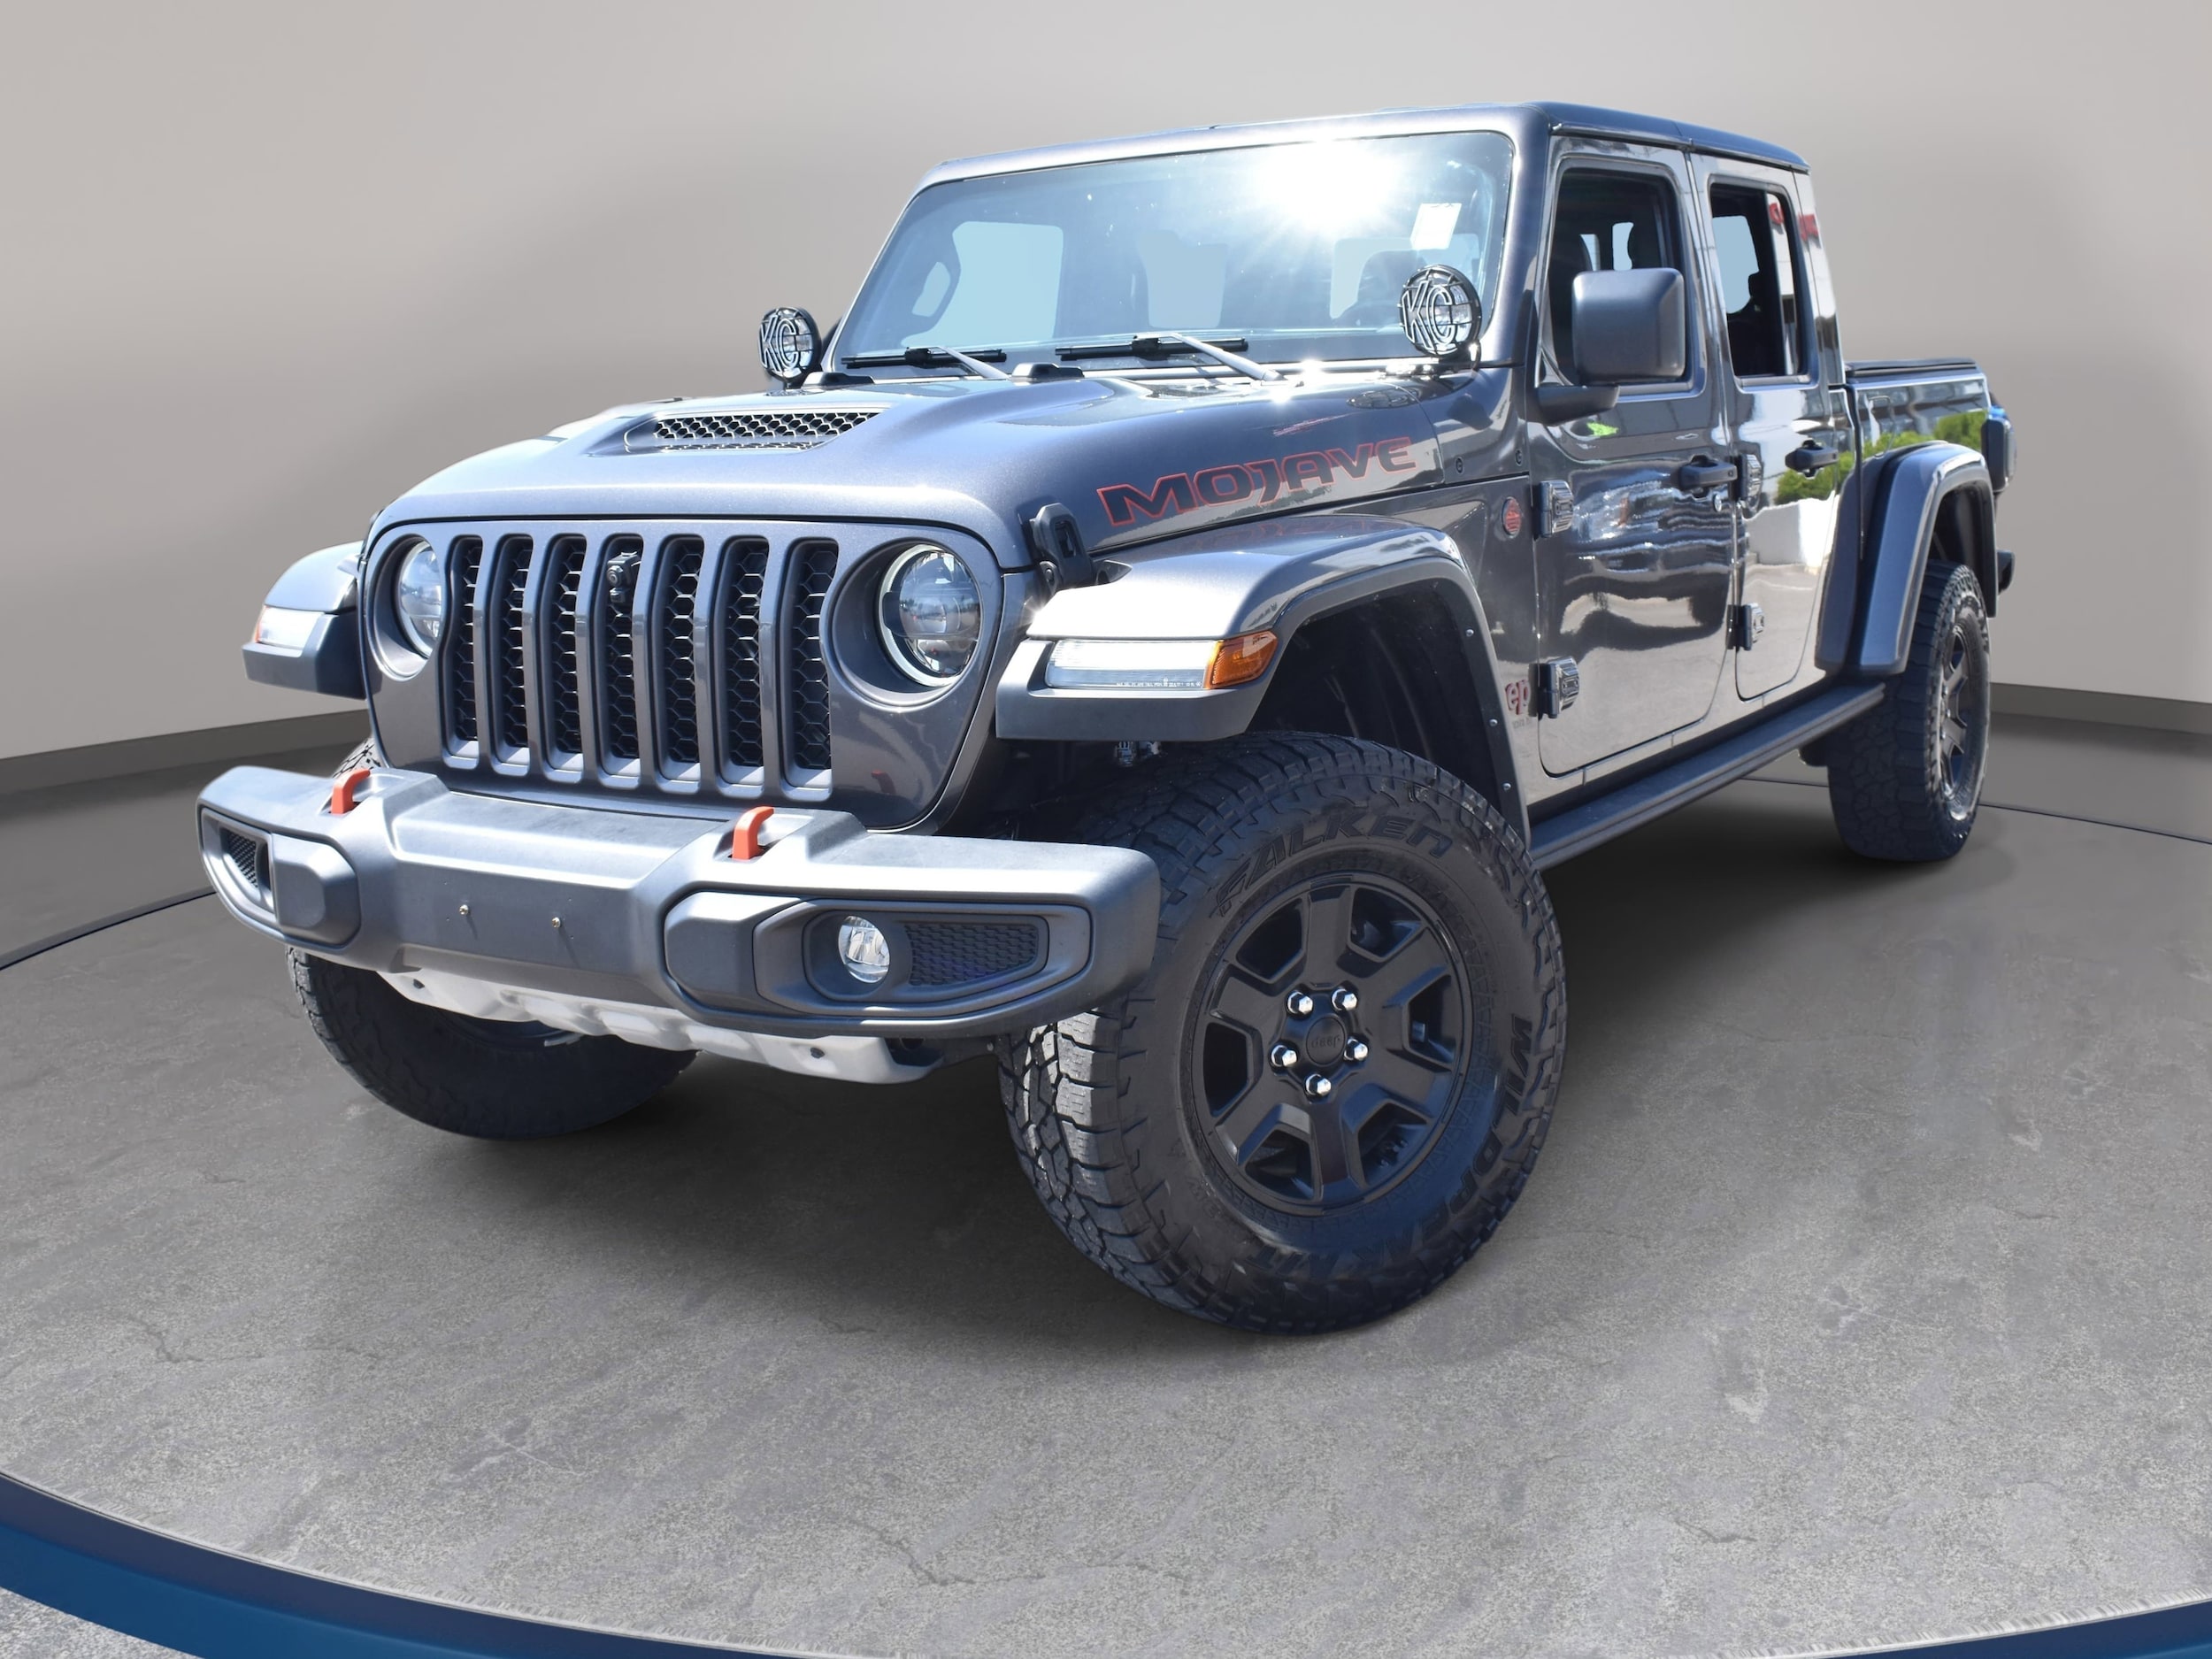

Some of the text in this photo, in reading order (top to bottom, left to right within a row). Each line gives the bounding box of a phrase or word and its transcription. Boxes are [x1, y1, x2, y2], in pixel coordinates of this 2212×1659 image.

[758, 314, 799, 373] KC
[1401, 280, 1455, 350] KC
[1097, 437, 1417, 526] MOJAVE
[1504, 680, 1532, 715] ep
